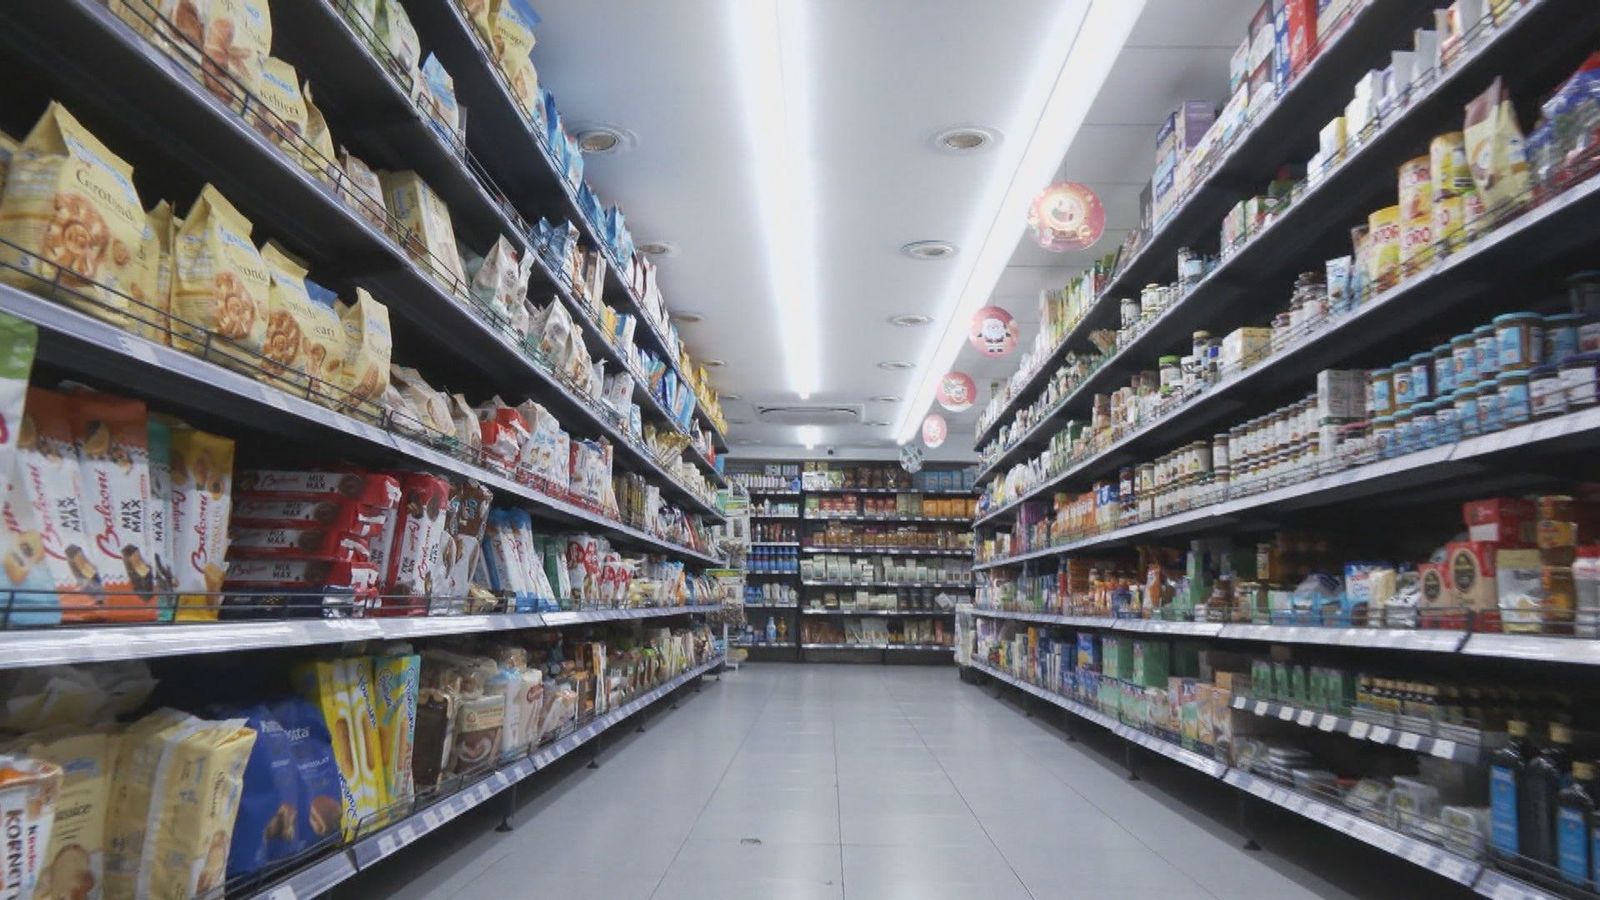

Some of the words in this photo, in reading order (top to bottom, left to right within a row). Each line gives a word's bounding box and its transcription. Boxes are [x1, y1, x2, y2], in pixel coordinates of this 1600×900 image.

[306, 481, 326, 490] MAX
[94, 468, 124, 560] Balconi
[121, 500, 131, 529] MIX
[131, 500, 142, 533] MAX
[191, 493, 208, 575] Balconi
